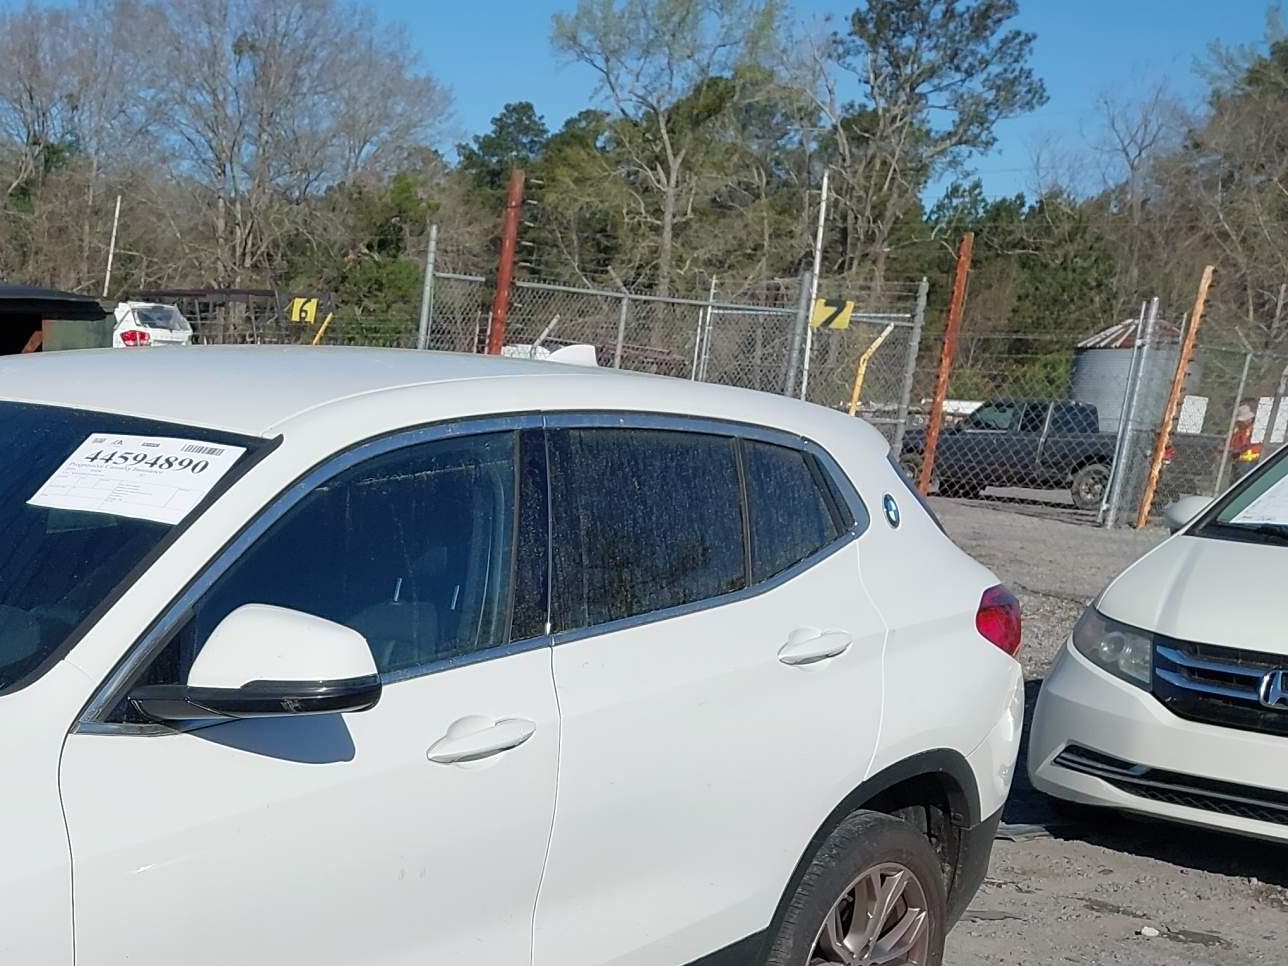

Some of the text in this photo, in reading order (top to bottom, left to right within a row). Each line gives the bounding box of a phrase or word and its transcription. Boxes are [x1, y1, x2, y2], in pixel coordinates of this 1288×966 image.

[299, 297, 312, 322] 6
[820, 298, 847, 328] 7
[85, 449, 209, 474] 44594890
